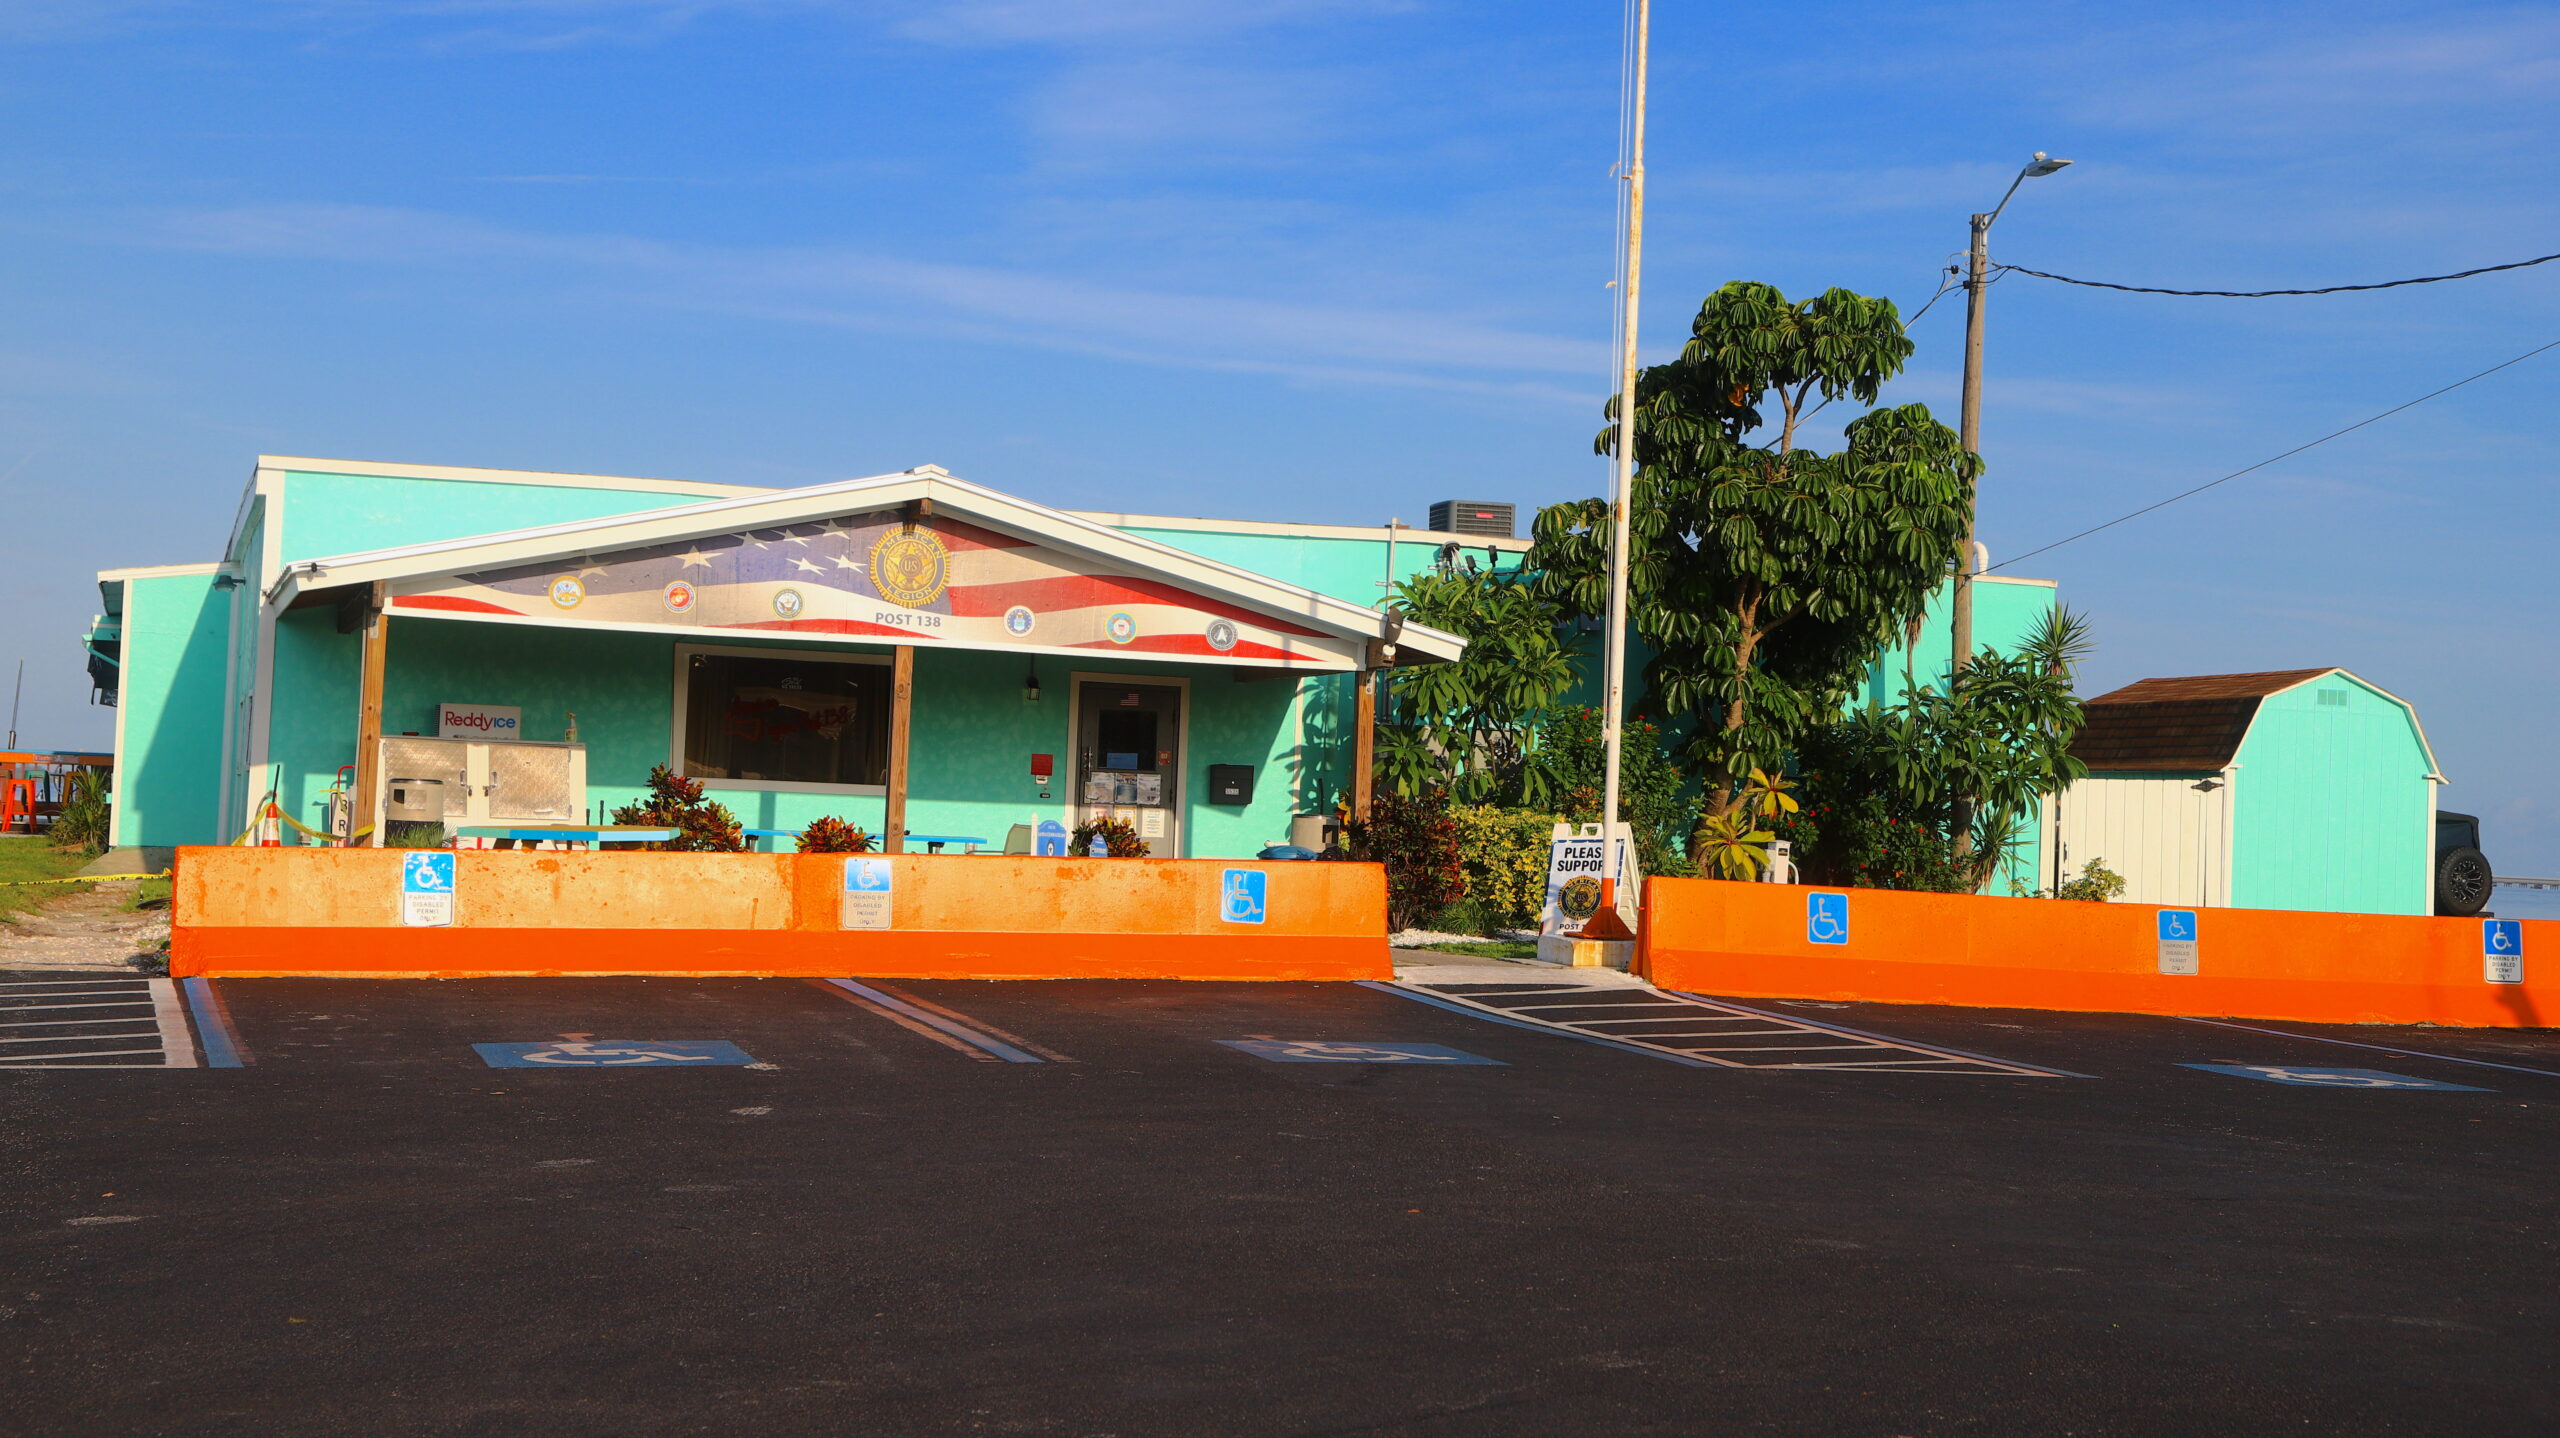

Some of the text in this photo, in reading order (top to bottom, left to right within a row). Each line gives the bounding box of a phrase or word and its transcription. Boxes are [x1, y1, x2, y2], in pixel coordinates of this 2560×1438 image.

[880, 532, 942, 559] AMERICAN
[903, 559, 918, 572] US
[886, 584, 934, 600] LEGION
[875, 612, 941, 627] POST 138
[1564, 847, 1603, 859] PLEAS
[1557, 860, 1603, 872] SUPPOR
